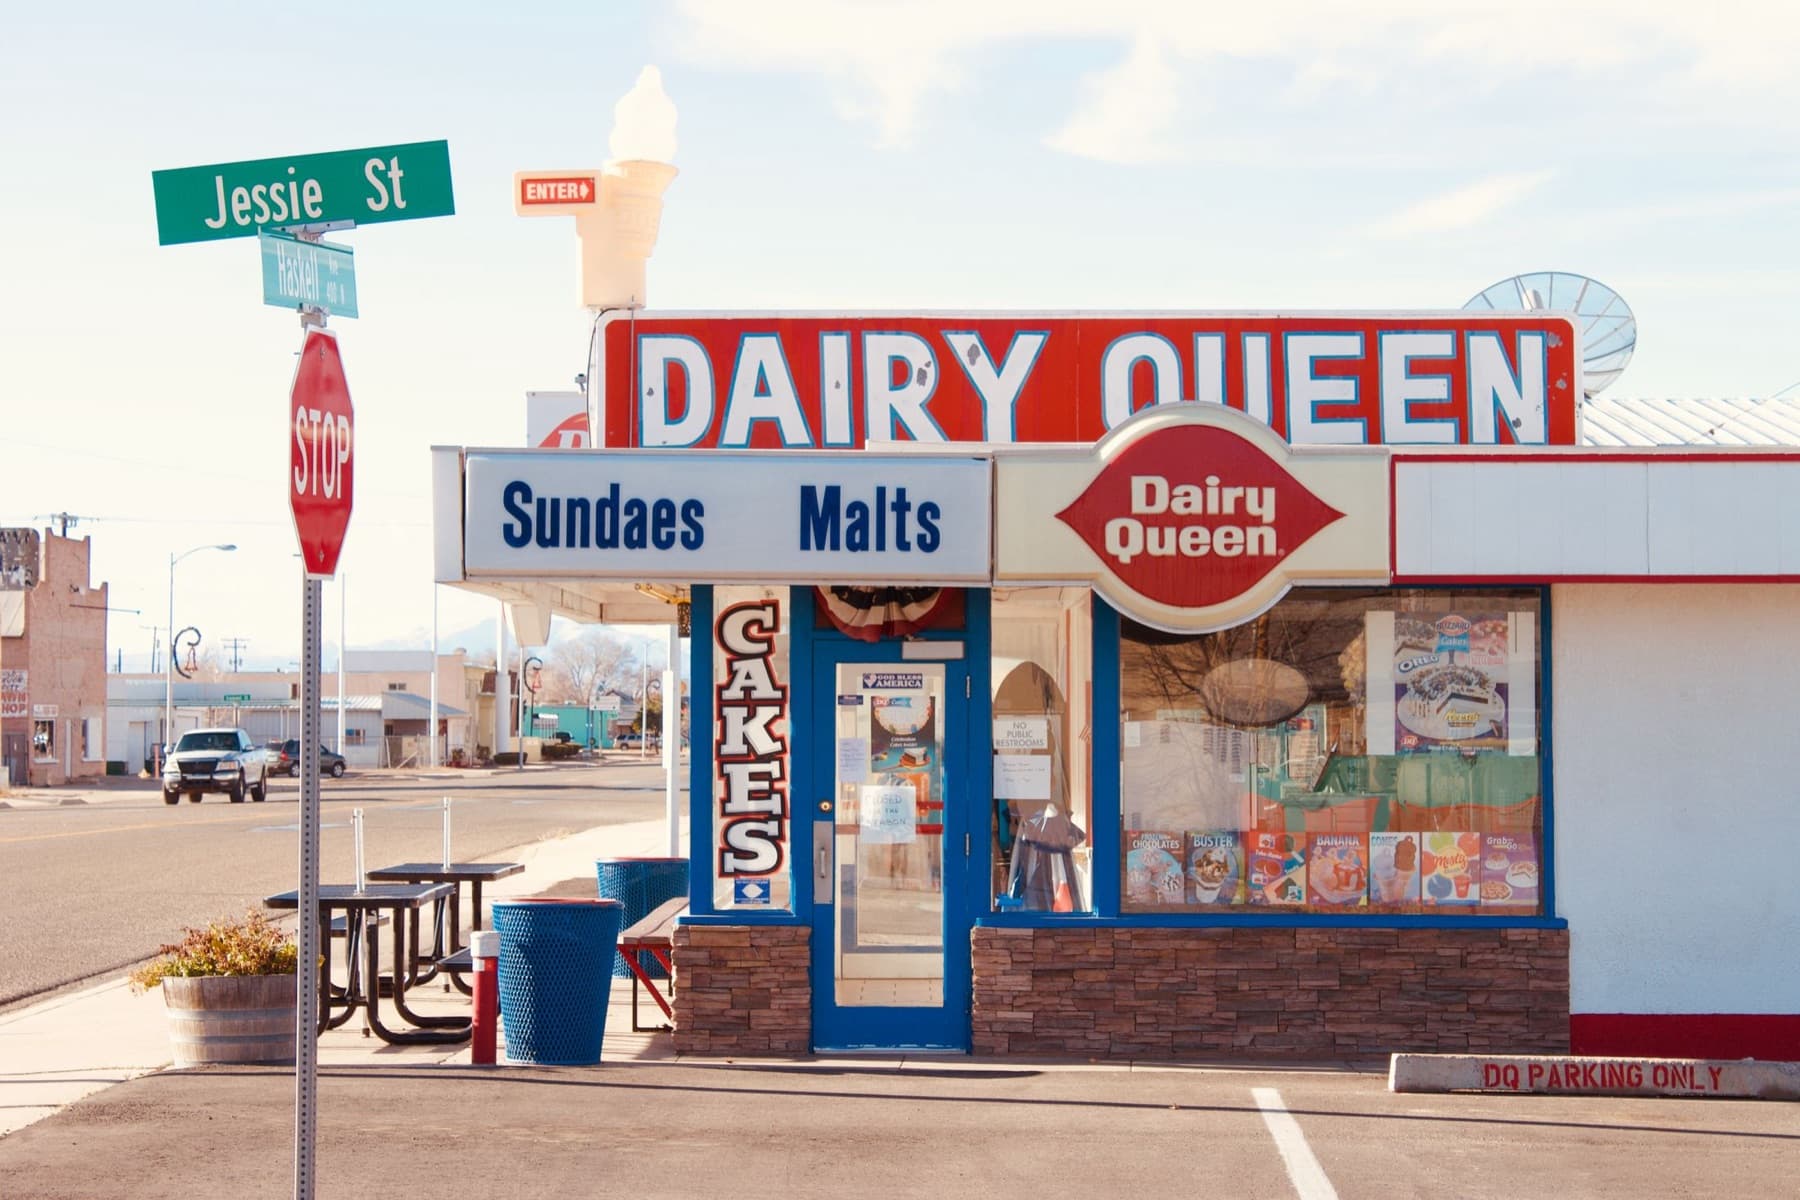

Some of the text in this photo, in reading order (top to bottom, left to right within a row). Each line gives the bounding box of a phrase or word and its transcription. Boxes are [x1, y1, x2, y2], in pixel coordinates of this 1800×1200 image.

[205, 156, 407, 229] Jessie St
[526, 182, 579, 200] ENTER
[277, 242, 320, 301] Haskell
[637, 329, 1549, 449] DAIRY QUEEN
[294, 405, 350, 499] STOP
[1130, 475, 1276, 524] Dairy
[502, 480, 941, 553] Sundaes Malts
[1104, 517, 1277, 565] Queen
[1399, 654, 1439, 672] OREO
[2, 703, 26, 714] HOP
[1007, 730, 1033, 738] PUBLIC
[1013, 721, 1027, 729] NO
[716, 600, 788, 878] CAKES
[996, 739, 1045, 747] RESTROOMS
[1132, 839, 1180, 849] CHOCOLATES
[1193, 836, 1233, 848] BUSTER
[1316, 834, 1360, 846] BANANA
[1486, 836, 1508, 845] Grab
[1506, 841, 1518, 850] Go
[1433, 852, 1468, 869] Misty
[1483, 1063, 1723, 1091] DQ PARKING ONLY
